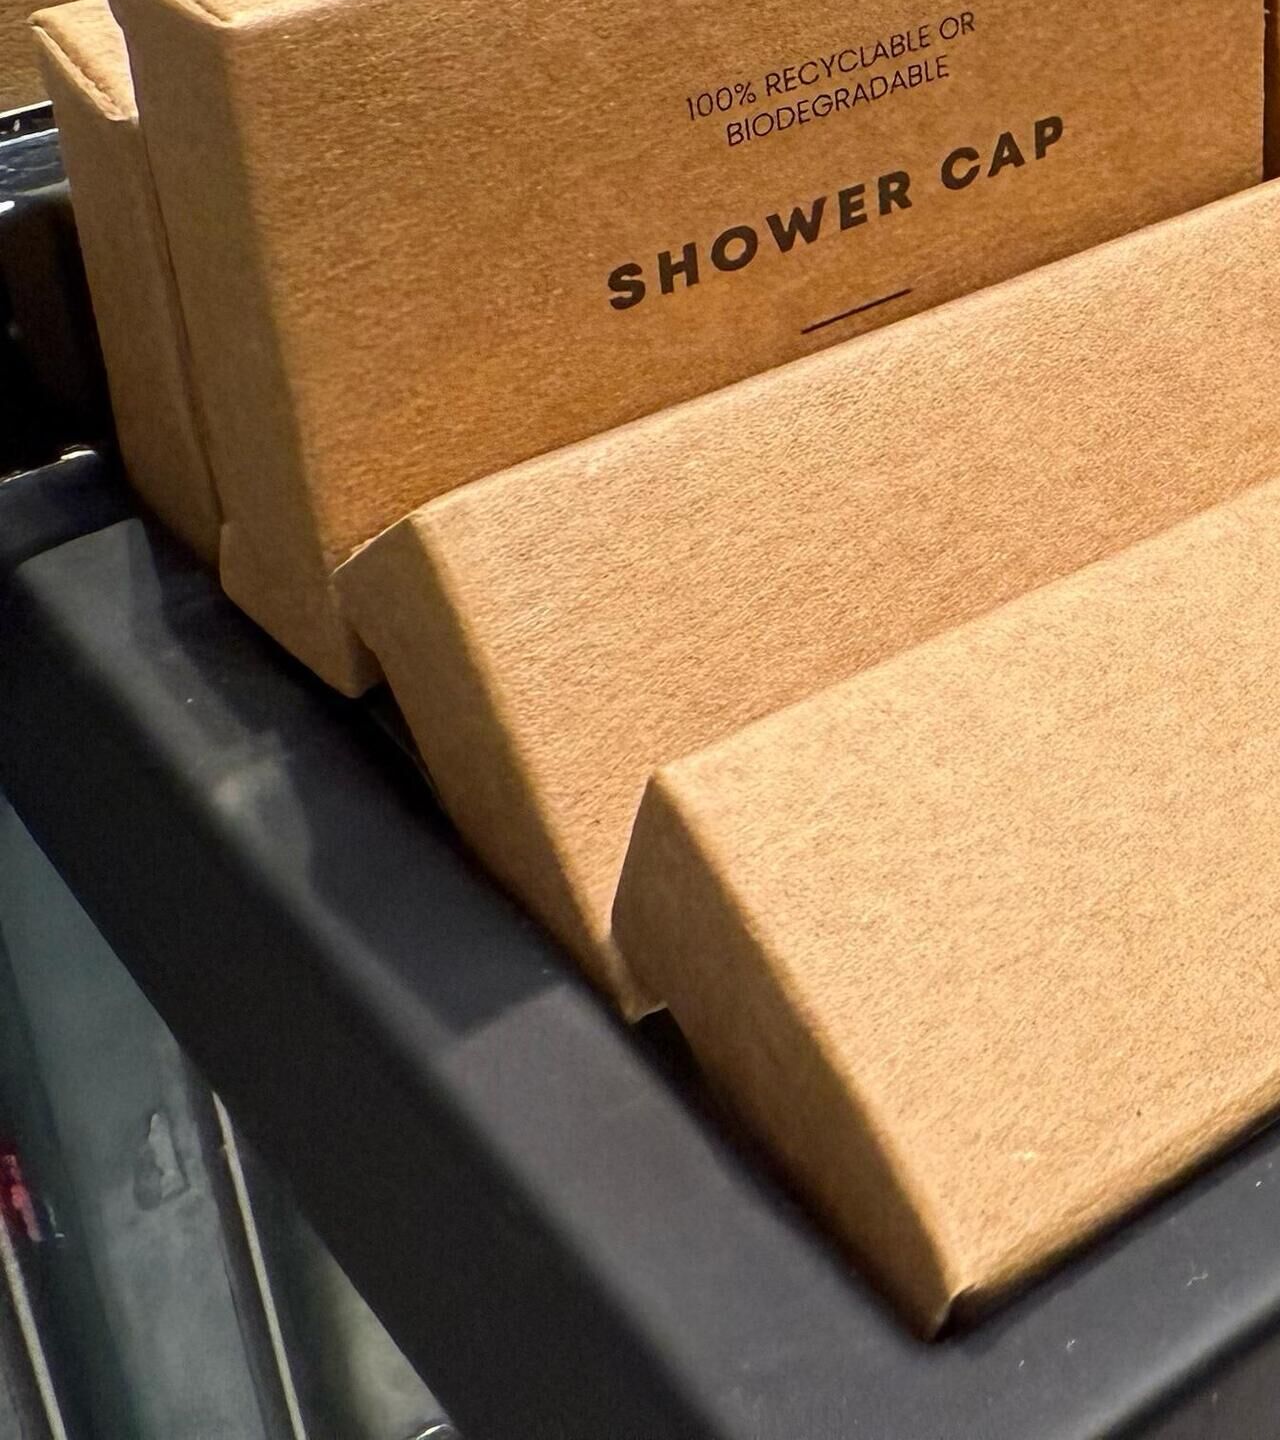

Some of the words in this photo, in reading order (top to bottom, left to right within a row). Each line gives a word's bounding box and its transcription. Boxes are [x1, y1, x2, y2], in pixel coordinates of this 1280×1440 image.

[686, 82, 757, 121] 100%
[765, 25, 930, 96] RECYCLABLE
[939, 11, 976, 40] OR
[726, 55, 950, 147] BIODEGRADABLE
[607, 170, 912, 311] SHOWER
[940, 116, 1064, 190] CAP
